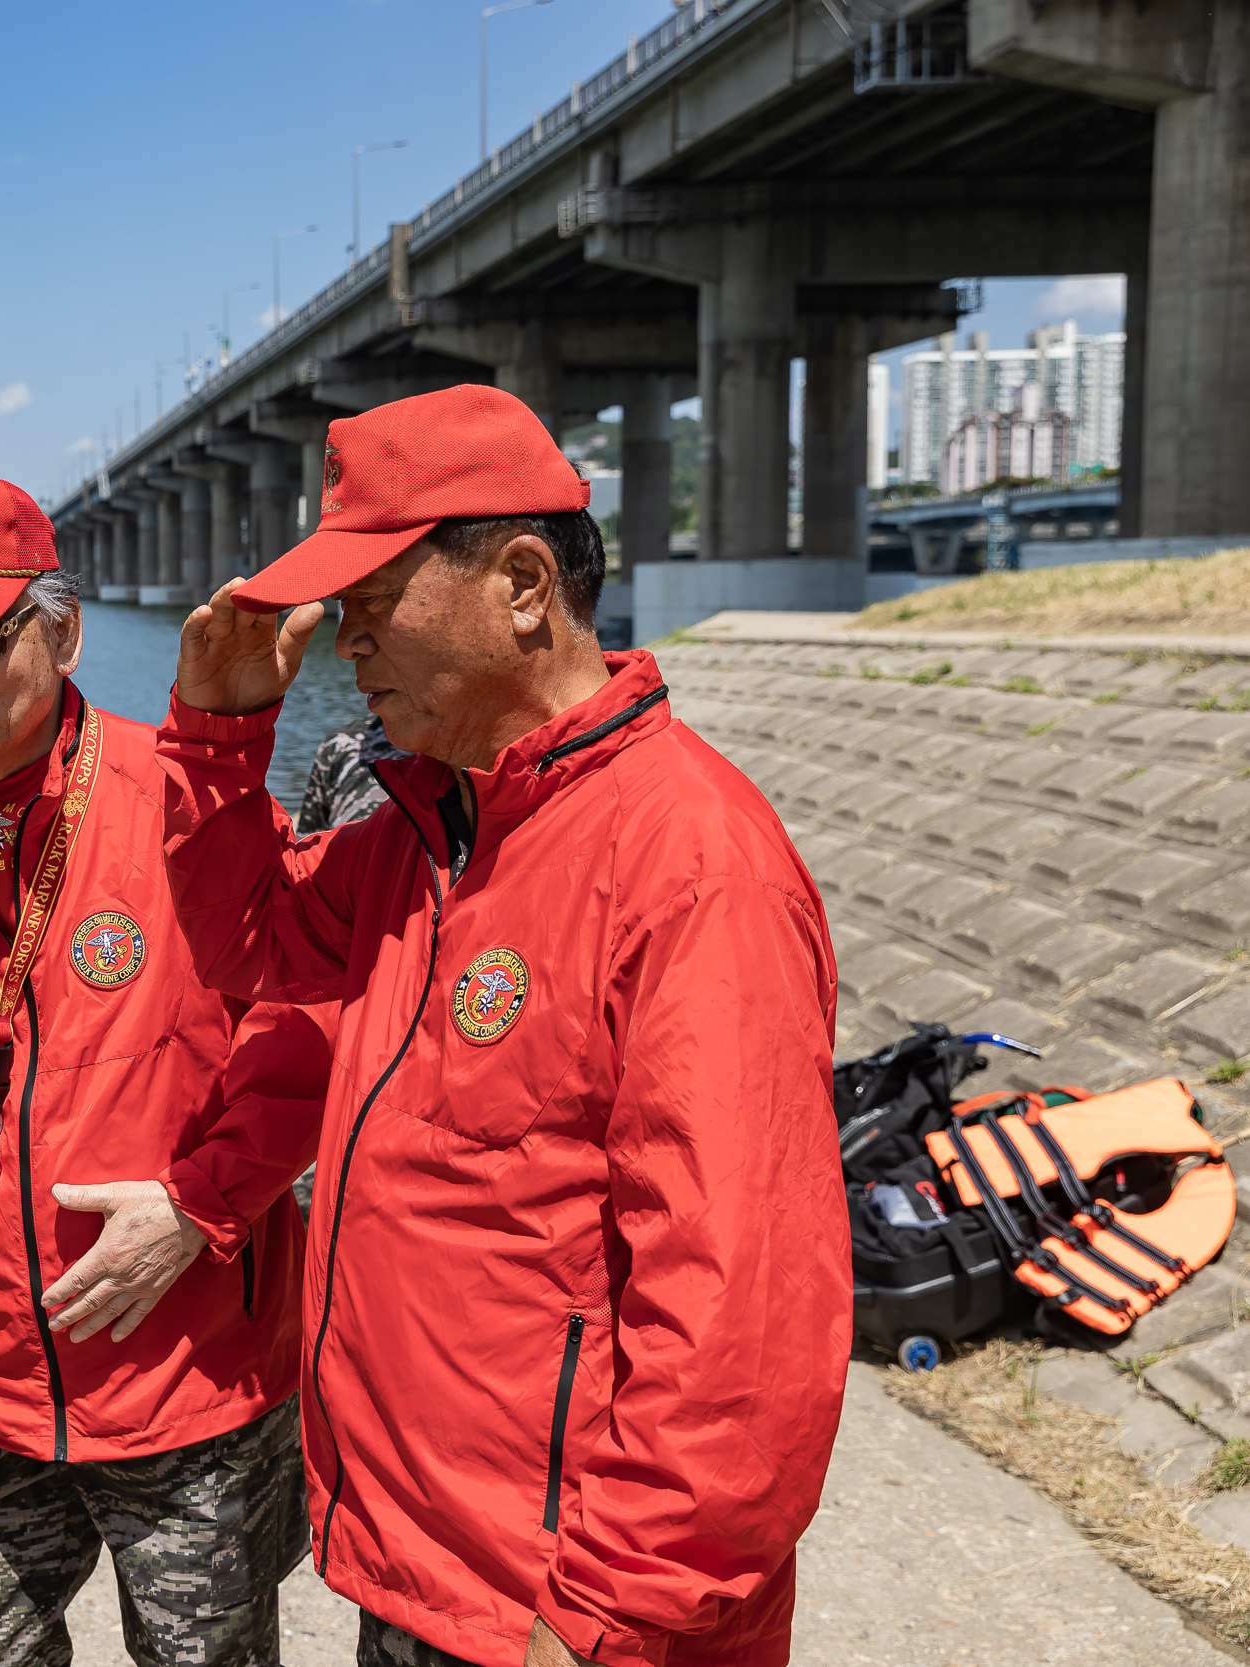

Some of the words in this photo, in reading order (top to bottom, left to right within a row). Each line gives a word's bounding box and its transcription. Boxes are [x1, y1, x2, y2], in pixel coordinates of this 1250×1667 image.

[90, 972, 120, 982] MARINE
[120, 959, 139, 978] CORPS
[458, 1010, 480, 1036] MARINE
[480, 1020, 504, 1036] CORPS
